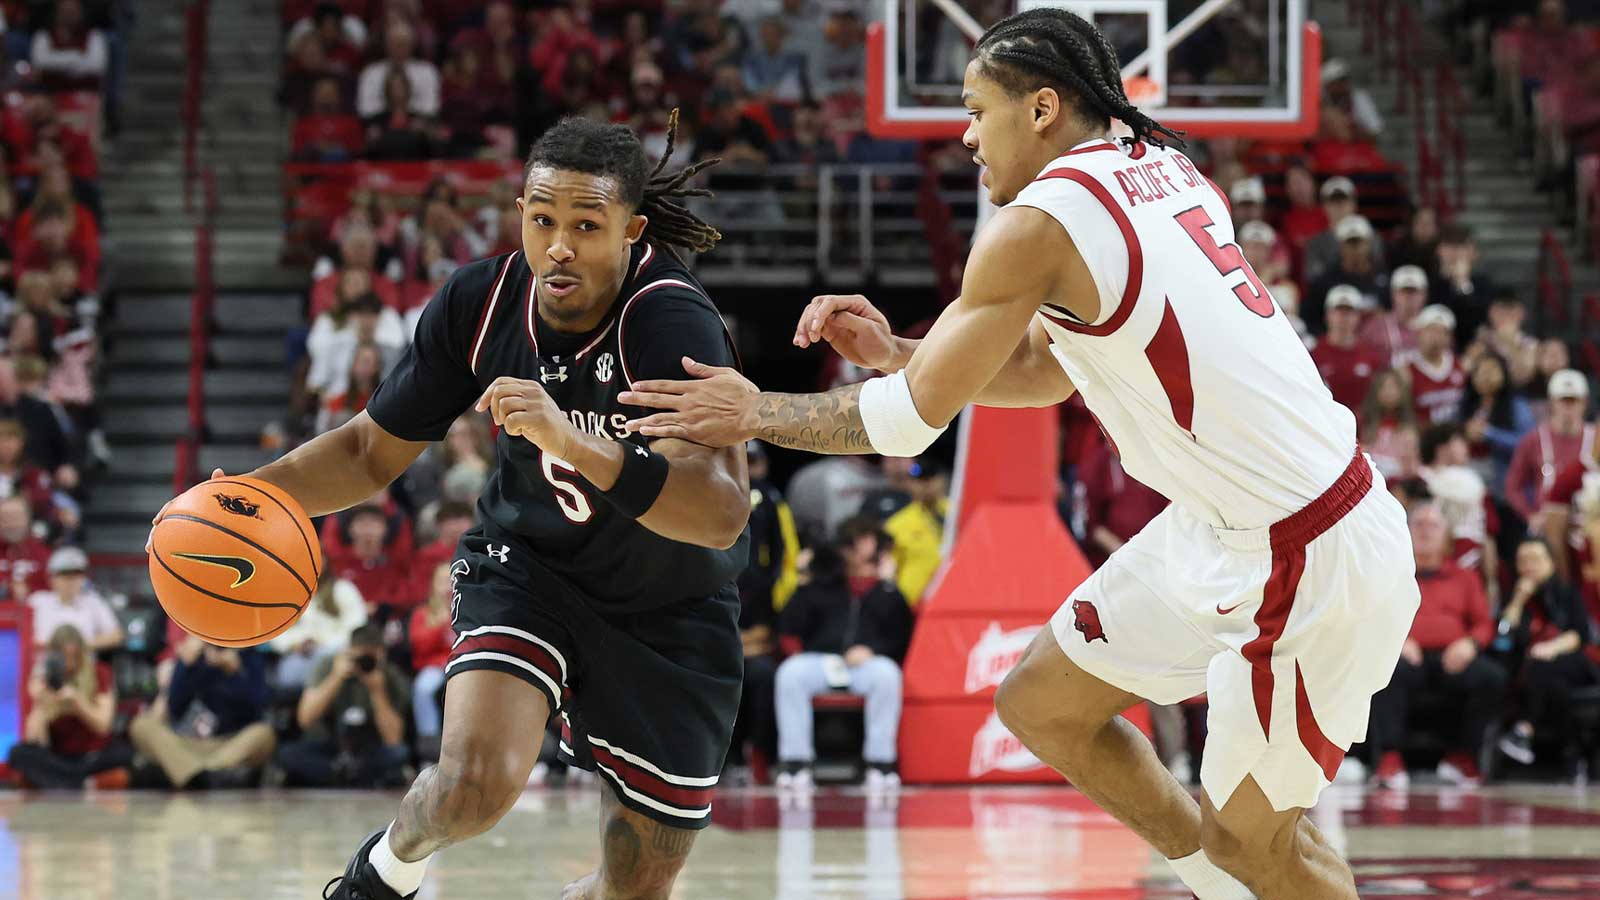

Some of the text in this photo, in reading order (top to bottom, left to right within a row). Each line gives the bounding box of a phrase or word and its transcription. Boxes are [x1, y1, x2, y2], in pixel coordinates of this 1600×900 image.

[1113, 160, 1181, 207] ACUFF
[1173, 205, 1275, 318] 5
[595, 352, 614, 383] SEC
[800, 426, 830, 450] No
[540, 450, 595, 525] 5
